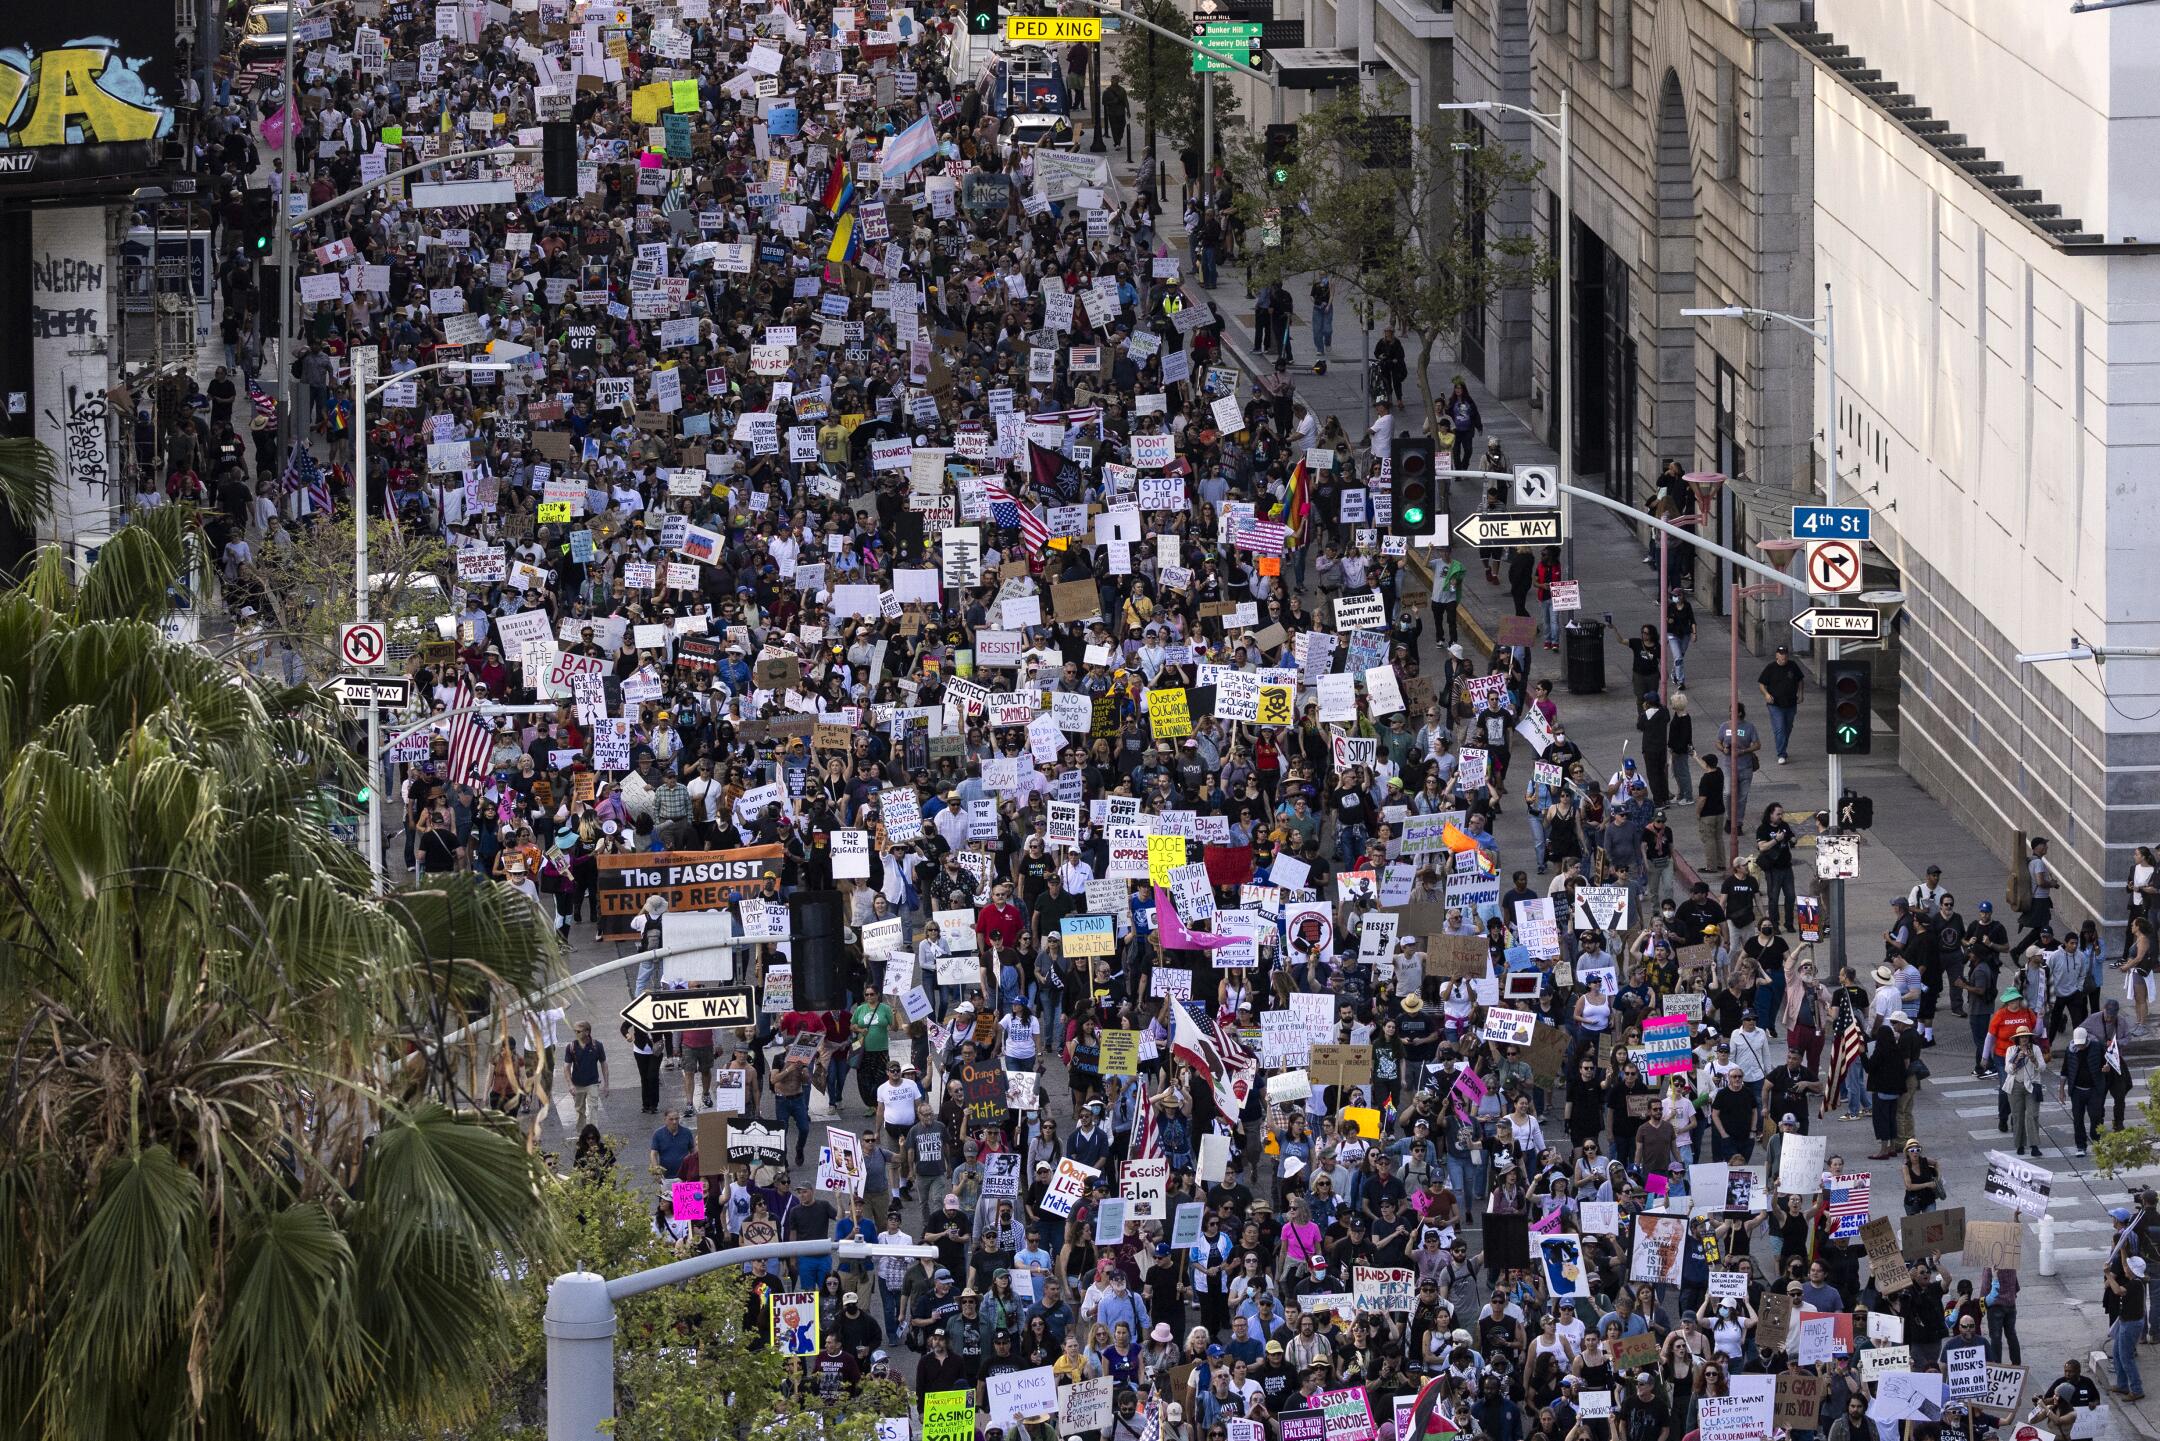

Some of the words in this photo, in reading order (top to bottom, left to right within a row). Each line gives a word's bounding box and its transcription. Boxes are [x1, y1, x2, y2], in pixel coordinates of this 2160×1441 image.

[394, 4, 408, 13] WE
[393, 12, 413, 22] RISE
[1016, 24, 1048, 37] PED
[1056, 22, 1093, 36] XING
[1207, 26, 1229, 34] Bunker
[1231, 26, 1243, 34] Hill
[1207, 39, 1232, 48] Jewelry
[1234, 39, 1248, 47] Dist
[1044, 94, 1057, 102] 52
[762, 247, 785, 255] DEFEND
[568, 325, 596, 337] HANDS
[572, 337, 592, 349] OFF
[752, 349, 780, 358] FUCK
[845, 350, 870, 361] RESIST
[599, 381, 629, 393] HANDS
[604, 393, 624, 404] OFF
[1136, 437, 1166, 446] DONT
[797, 448, 815, 457] CARE
[873, 446, 912, 460] STRONGER
[1137, 448, 1169, 457] LOOK
[1136, 458, 1168, 466] AWAY
[1143, 480, 1182, 491] STOP
[1142, 497, 1181, 509] COUP
[1803, 513, 1834, 533] 4th
[1841, 515, 1860, 533] St
[1479, 523, 1508, 537] ONE
[1520, 521, 1551, 536] WAY
[1163, 568, 1189, 585] RESIST
[1342, 595, 1375, 605] SEEKING
[1337, 607, 1365, 617] SANITY
[1367, 606, 1383, 614] AND
[1340, 616, 1380, 628] HUMANITY
[1817, 617, 1841, 628] ONE
[1845, 617, 1869, 628] WAY
[981, 642, 1019, 654] RESIST!
[562, 653, 602, 672] BAD
[949, 676, 988, 701] PROTECT
[1468, 676, 1503, 690] DEPORT
[347, 687, 371, 697] ONE
[377, 687, 399, 699] WAY
[1061, 693, 1078, 703] NO
[1471, 687, 1506, 699] MUSK
[947, 692, 966, 706] THE
[968, 700, 983, 715] VA
[1053, 701, 1088, 714] Oligarchs
[393, 735, 429, 748] TRAITOR
[395, 749, 427, 761] TRUMP
[1348, 742, 1374, 762] STOP!
[1536, 763, 1559, 773] TAX
[1536, 773, 1561, 785] RICH
[887, 793, 910, 804] SAVE
[1111, 799, 1136, 807] HANDS
[973, 801, 990, 809] STOP
[1111, 806, 1134, 815] OFF!
[889, 815, 918, 827] PROTECT
[1053, 813, 1075, 822] OFF!
[1107, 815, 1136, 825] LGBTQ+
[888, 824, 922, 836] DEMOCRACY
[1049, 823, 1076, 831] SOCIAL
[1115, 829, 1143, 839] REAL
[1110, 840, 1147, 848] AMERICANS
[1149, 837, 1181, 851] DOGE
[832, 846, 868, 855] OLIGARCHY
[1114, 849, 1148, 859] OPPOSE
[621, 869, 661, 887] The
[669, 861, 762, 885] FASCIST
[1215, 912, 1249, 923] MORONS
[1070, 918, 1104, 931] STAND
[1365, 923, 1394, 931] RESIST
[1064, 941, 1113, 955] UKRAINE
[1155, 979, 1181, 988] SINCE
[1154, 987, 1189, 999] 1776
[652, 1002, 689, 1020] ONE
[702, 999, 740, 1018] WAY
[1263, 1011, 1301, 1023] WOMEN
[1490, 1010, 1512, 1021] Down
[1515, 1013, 1533, 1022] with
[1499, 1020, 1517, 1030] Turd
[1486, 1029, 1508, 1040] Reich
[1651, 1039, 1687, 1050] TRANS
[963, 1066, 1001, 1082] Orange
[1459, 1073, 1482, 1096] RESIST
[969, 1102, 1006, 1120] Matter
[917, 1133, 940, 1143] BLACK
[919, 1143, 940, 1151] LIVES
[730, 1147, 753, 1160] BLEAK
[760, 1147, 781, 1162] HOUSE
[919, 1151, 942, 1161] MATTER
[1121, 1162, 1167, 1178] Fascist!
[2008, 1163, 2031, 1181] NO
[986, 1178, 1015, 1186] RELEASE
[1835, 1173, 1870, 1182] TRAITOR
[826, 1178, 845, 1190] OFF!
[1988, 1175, 2048, 1201] CONCENTRATION
[1121, 1185, 1158, 1199] Felon
[1995, 1190, 2037, 1212] CAMPS!
[1355, 1269, 1389, 1281] HANDS
[1392, 1269, 1413, 1281] OFF
[1380, 1283, 1411, 1294] FIRST
[773, 1294, 814, 1305] PUTIN'S
[1954, 1350, 1976, 1360] STOP
[1872, 1357, 1907, 1366] PEOPLE
[1950, 1361, 1984, 1372] MUSK'S
[995, 1382, 1011, 1395] NO
[1018, 1377, 1045, 1390] KINGS
[1951, 1377, 1970, 1386] WAR
[1973, 1376, 1984, 1384] ON
[1792, 1380, 1816, 1394] GAZA
[1951, 1385, 1986, 1394] WORKERS!
[1321, 1392, 1349, 1407] STOP
[1714, 1398, 1738, 1406] THEY
[1741, 1396, 1764, 1404] WANT
[1009, 1400, 1041, 1413] AMERICA!
[1702, 1407, 1720, 1417] DEI
[1799, 1401, 1814, 1416] YOU
[929, 1410, 973, 1422] CASINO
[1284, 1420, 1302, 1430] STAND
[1304, 1419, 1321, 1428] WITH
[1284, 1427, 1322, 1438] PALESTINE
